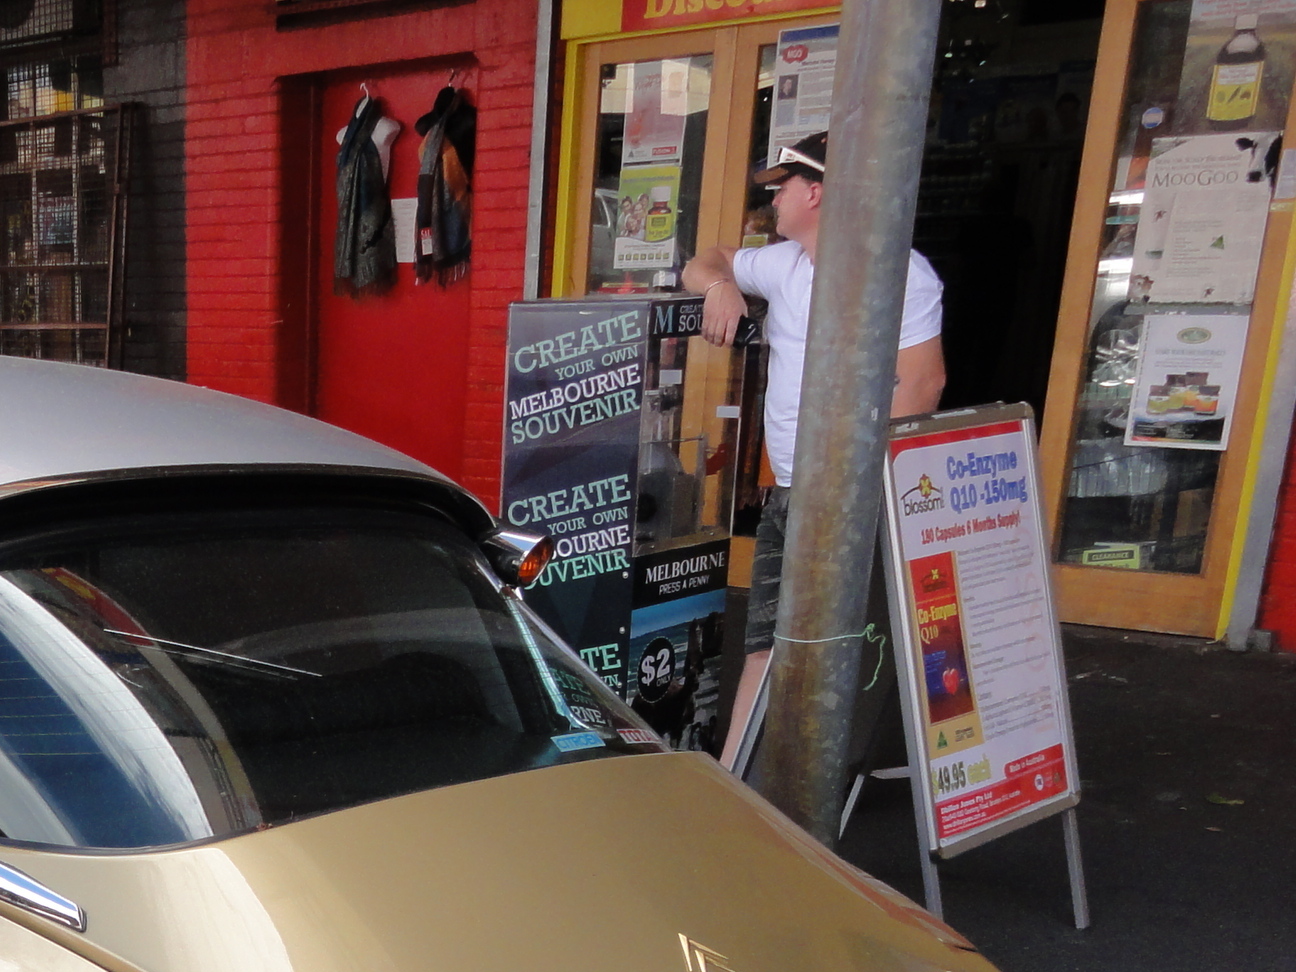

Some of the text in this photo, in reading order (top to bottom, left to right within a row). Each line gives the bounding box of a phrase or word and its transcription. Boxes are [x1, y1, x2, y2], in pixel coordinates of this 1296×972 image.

[653, 304, 704, 335] M CREAT
[514, 310, 642, 374] CREATE
[554, 344, 639, 381] YOUR OWN
[509, 363, 641, 420] MELBOURNE
[511, 388, 640, 444] SOUVENIR
[946, 451, 1018, 481] Co-Enzyme
[507, 473, 632, 527] CREATE
[903, 497, 942, 517] blossom
[950, 483, 978, 514] Q10
[547, 506, 629, 536] YOUR OWN
[966, 520, 972, 535] 6
[972, 515, 997, 533] Months
[552, 524, 631, 560] OURNE
[524, 548, 631, 590] UVENIR
[645, 551, 726, 585] MELBOURNE
[658, 574, 711, 596] PRESS A PENNY
[920, 624, 940, 645] Q10
[641, 648, 671, 686] $2
[656, 674, 672, 688] ONLY
